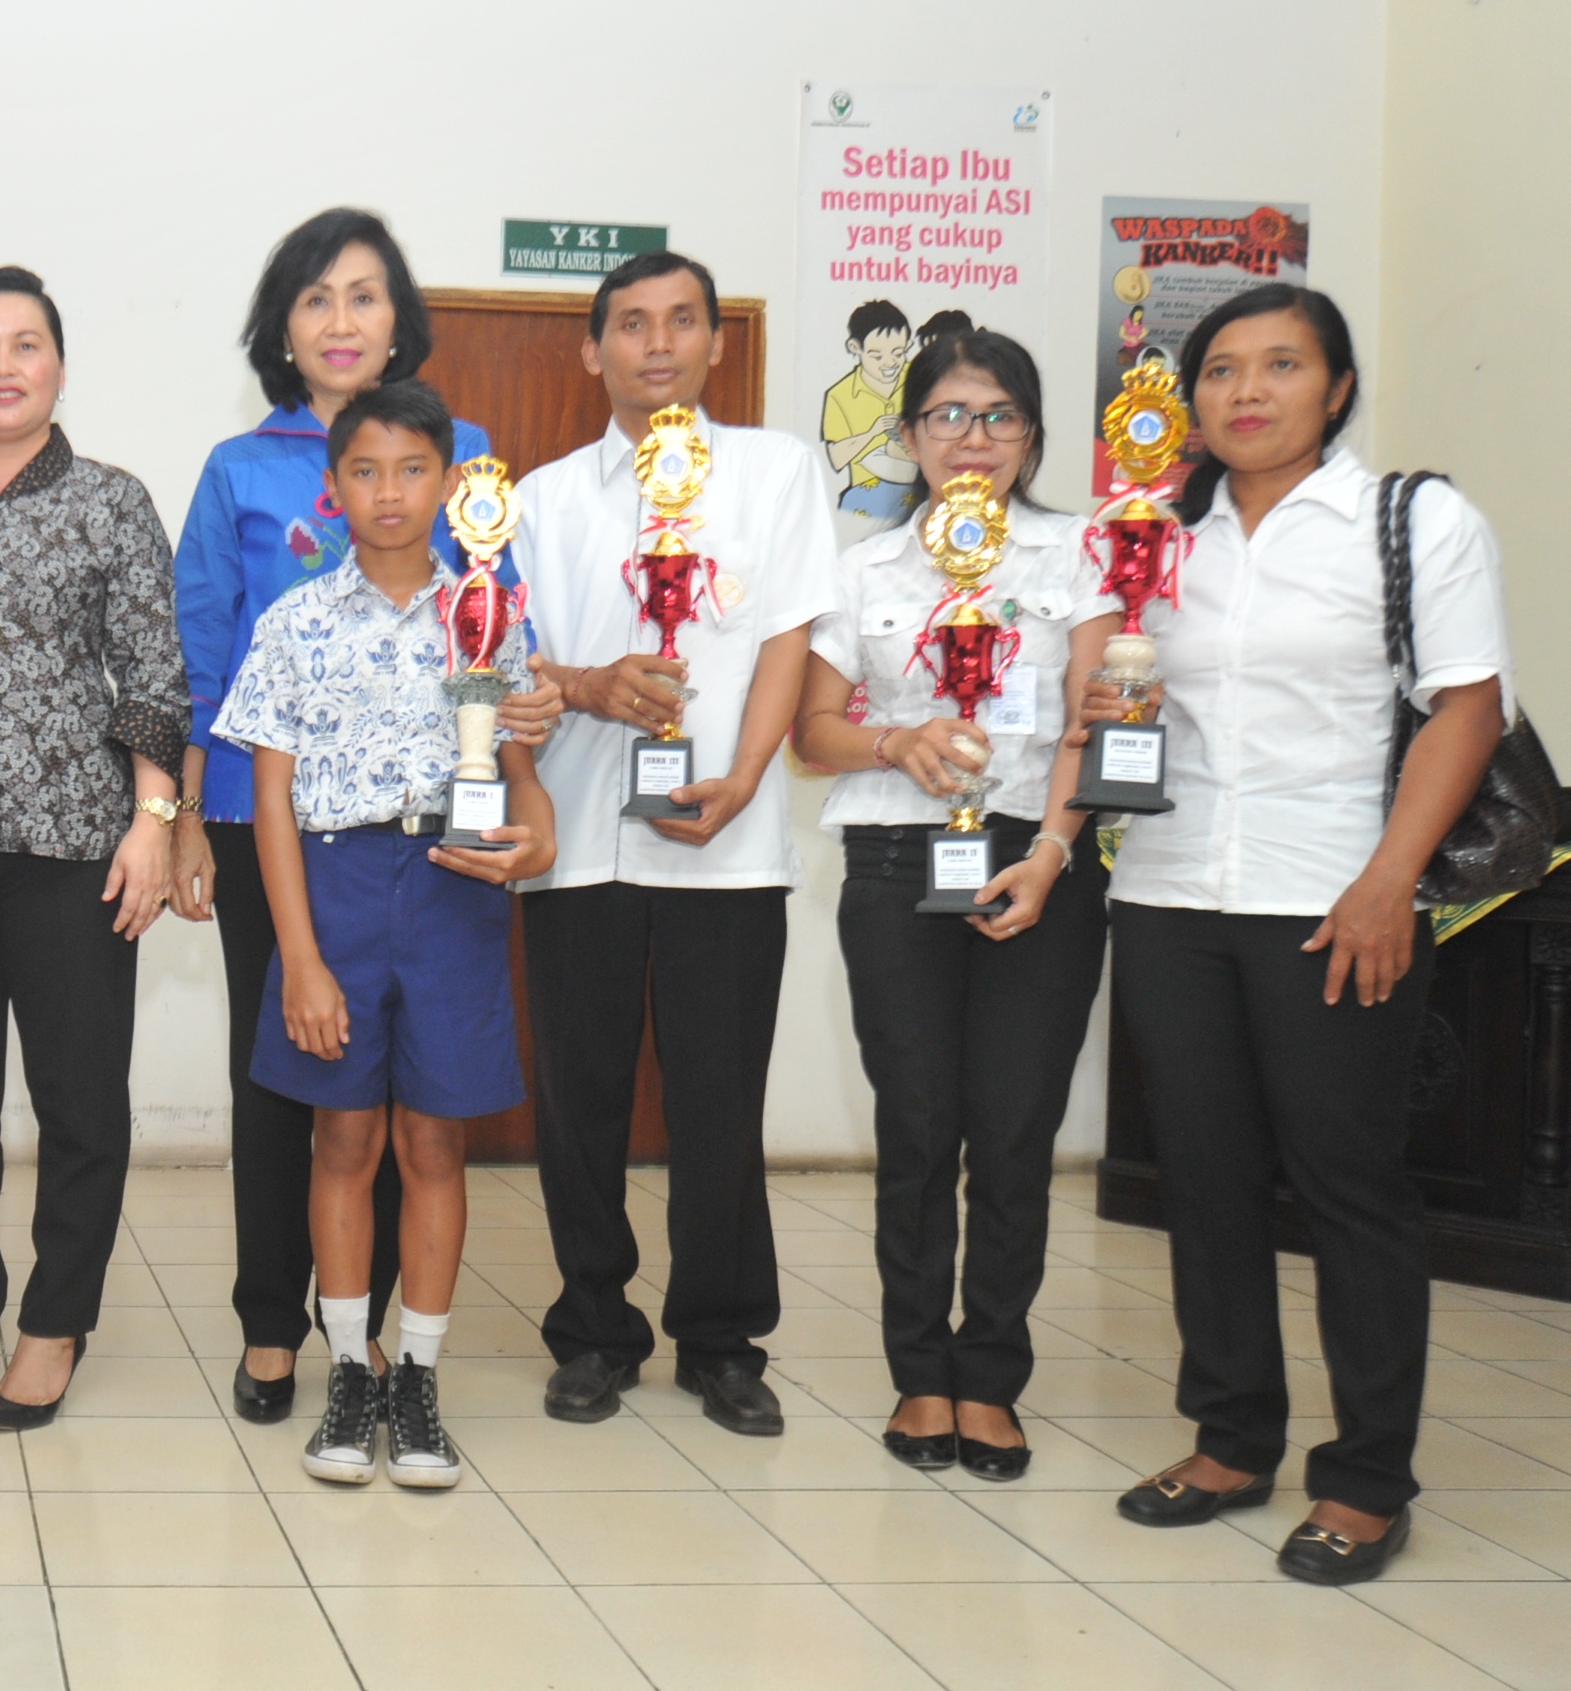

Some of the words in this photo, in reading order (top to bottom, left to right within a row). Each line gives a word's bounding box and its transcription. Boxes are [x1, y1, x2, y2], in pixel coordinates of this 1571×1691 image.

[842, 146, 949, 187] Setiap
[960, 149, 1010, 181] Ibu
[820, 189, 977, 219] mempunyai
[984, 189, 1030, 215] ASI
[846, 222, 912, 252] yang
[919, 221, 1003, 254] cukup
[1111, 217, 1248, 242] WASPADA
[509, 248, 557, 269] YAYASAN
[558, 250, 601, 272] KANKER
[830, 256, 909, 282] untuk
[917, 257, 1018, 291] bayinya
[1140, 240, 1278, 277] KANKER!!
